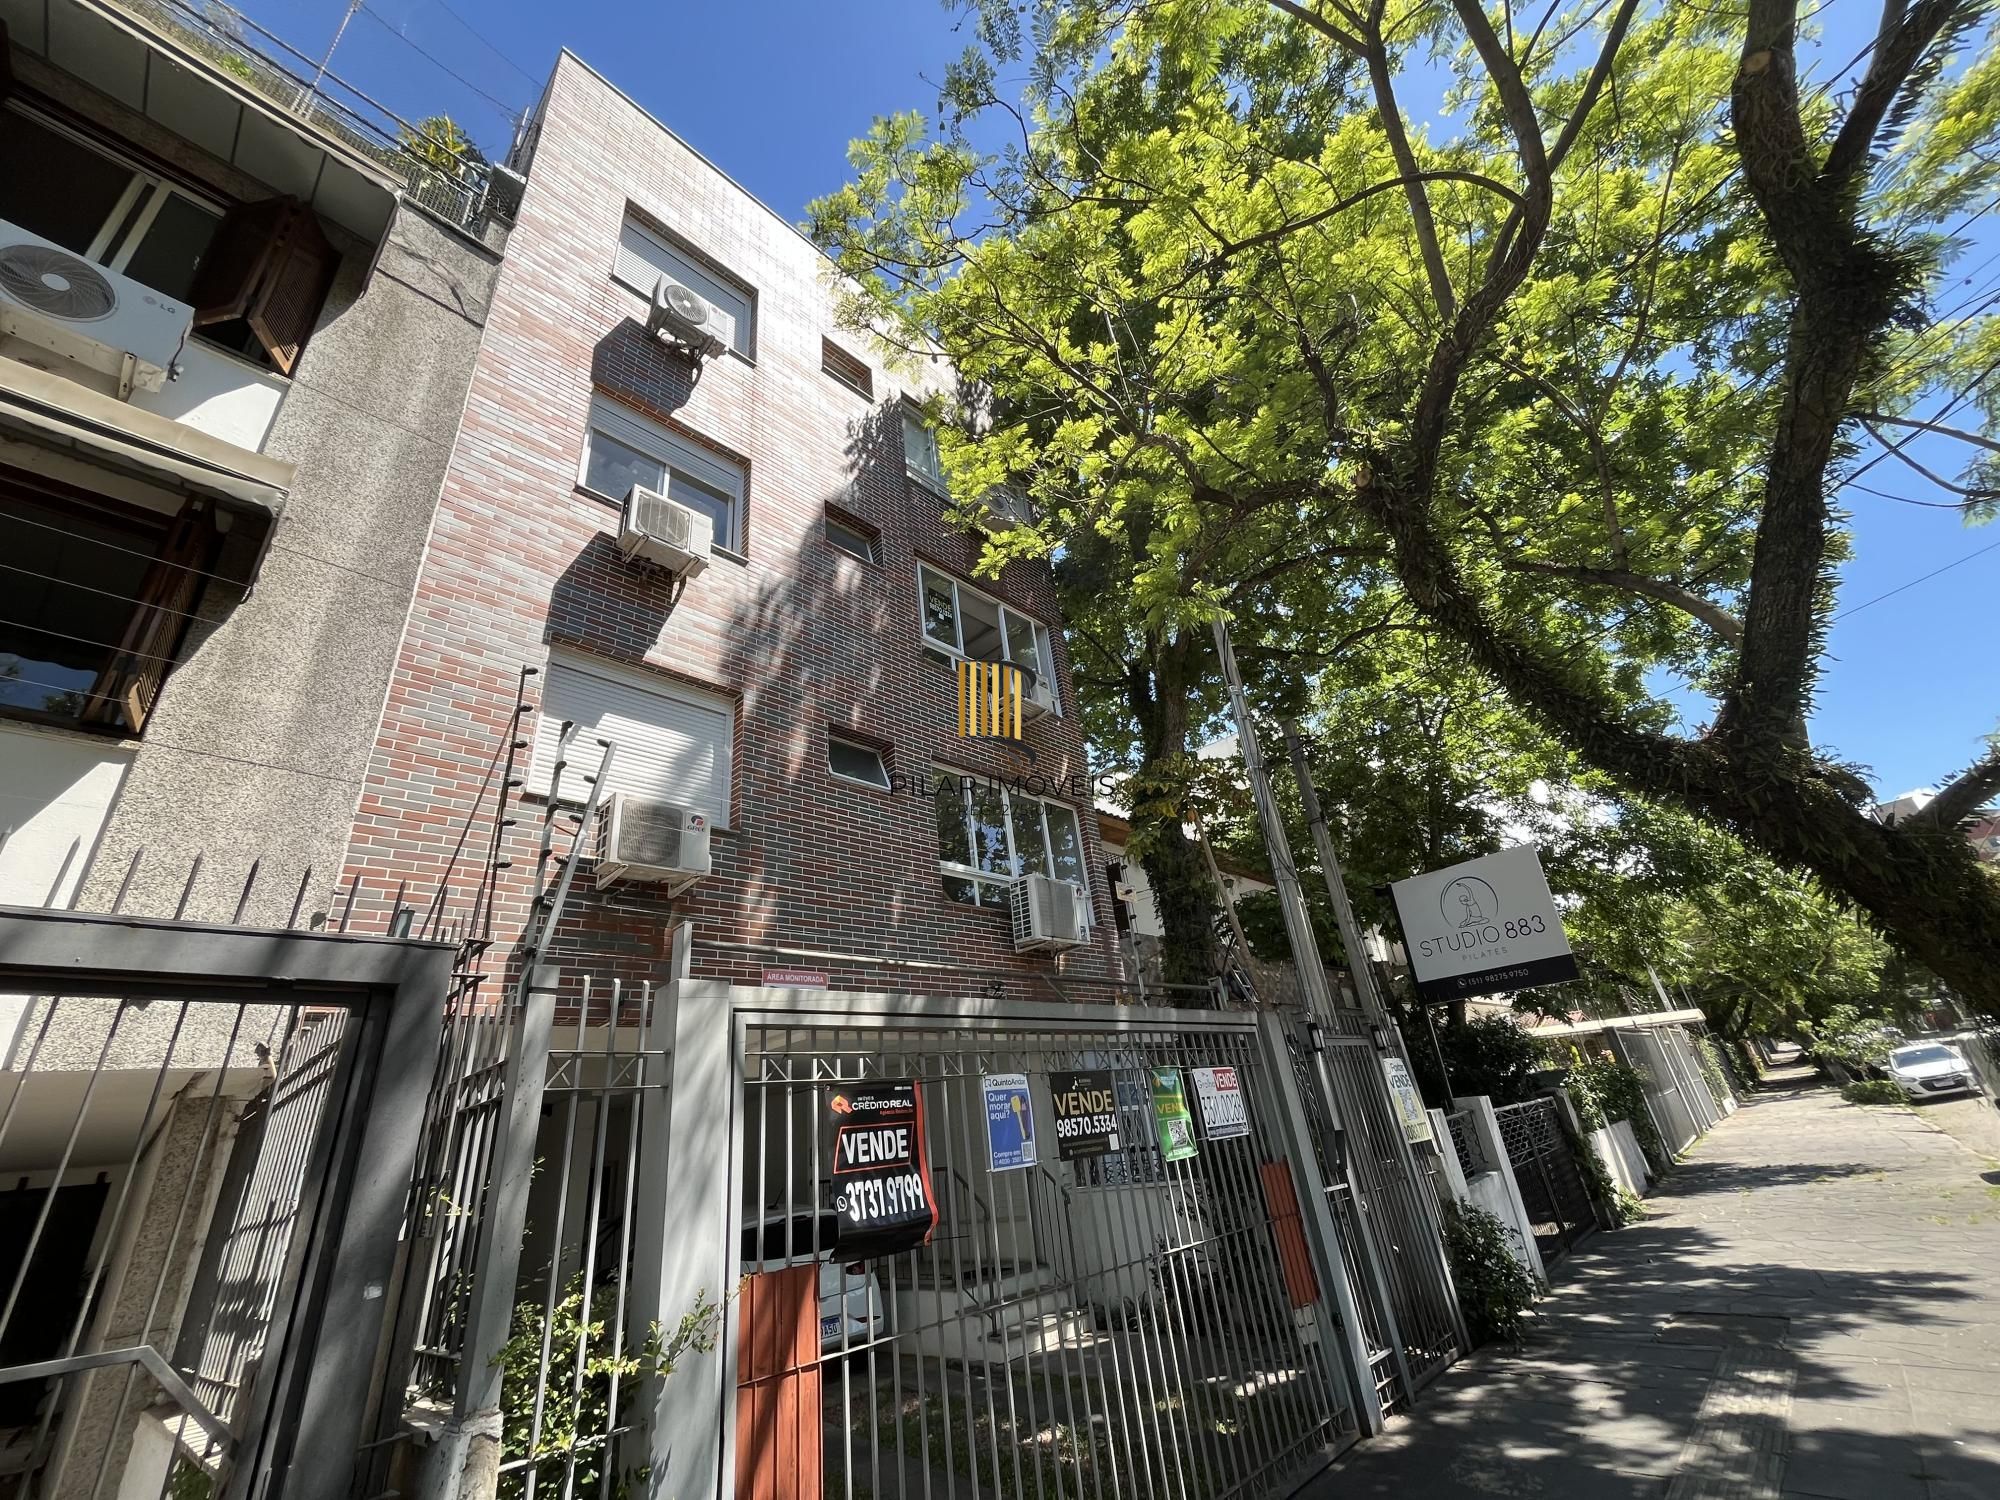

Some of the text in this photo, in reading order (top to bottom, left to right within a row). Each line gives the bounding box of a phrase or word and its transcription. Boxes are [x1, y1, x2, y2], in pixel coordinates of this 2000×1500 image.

[1419, 915, 1546, 957] STUDIO 883
[1462, 946, 1508, 961] PILATES
[766, 972, 824, 982] ÁREA MONITORADA
[1468, 977, 1483, 985] (51)
[991, 1078, 1026, 1087] QuintoAndar
[1214, 1072, 1238, 1088] VENDE
[988, 1092, 1007, 1102] Quer
[1053, 1090, 1114, 1116] VENDE
[989, 1102, 1011, 1111] morar
[990, 1109, 1010, 1121] aqui?
[1056, 1114, 1118, 1138] 98570.5334
[841, 1128, 909, 1164] VENDE
[845, 1173, 925, 1222] 3737.9799
